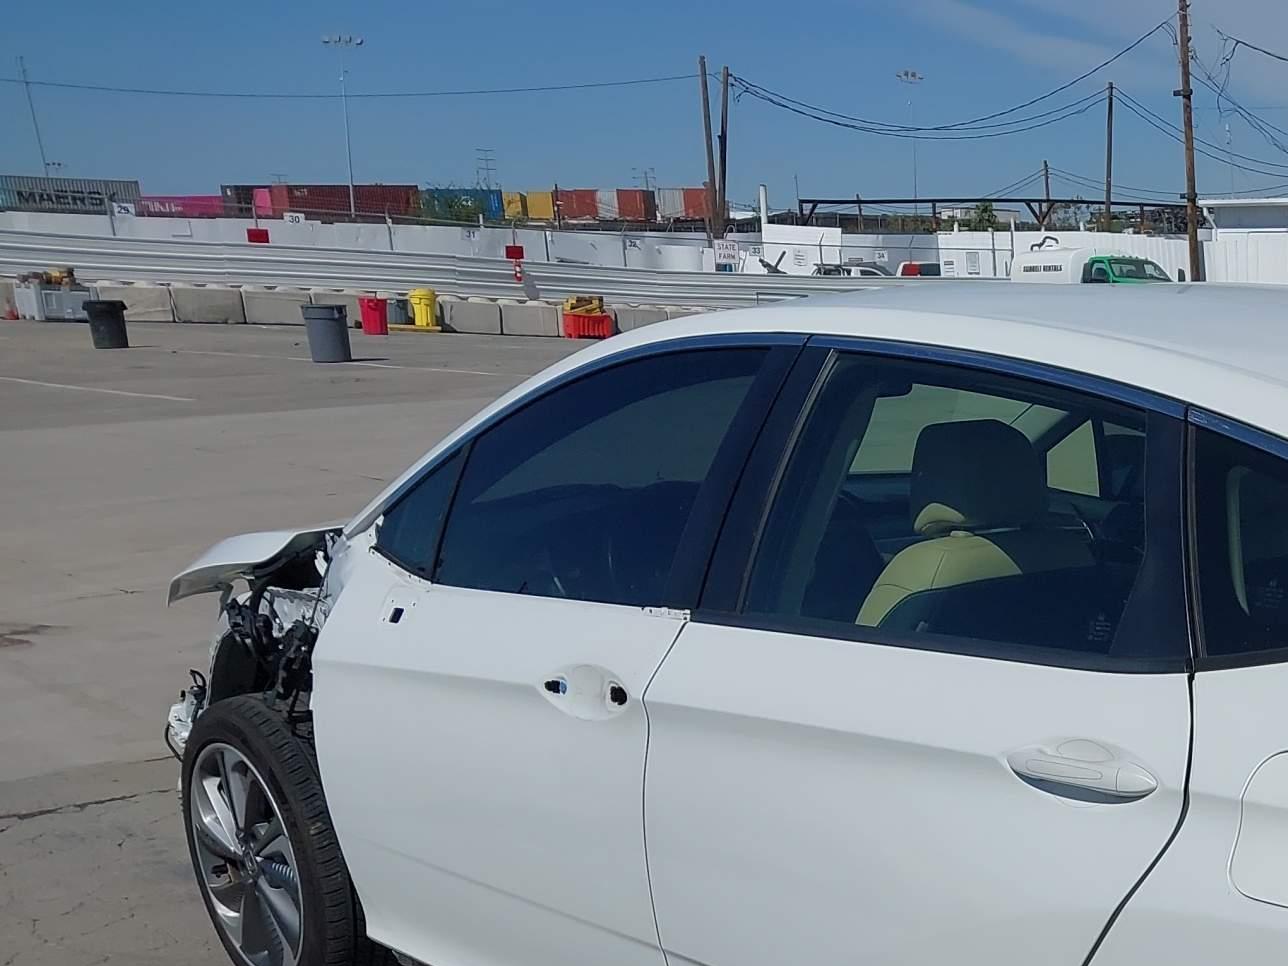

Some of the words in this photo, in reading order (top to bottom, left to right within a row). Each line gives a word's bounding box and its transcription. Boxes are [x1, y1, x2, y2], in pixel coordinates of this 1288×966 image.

[288, 215, 300, 224] 30
[717, 242, 736, 250] STATE
[751, 246, 761, 254] 33
[718, 252, 736, 260] FARM
